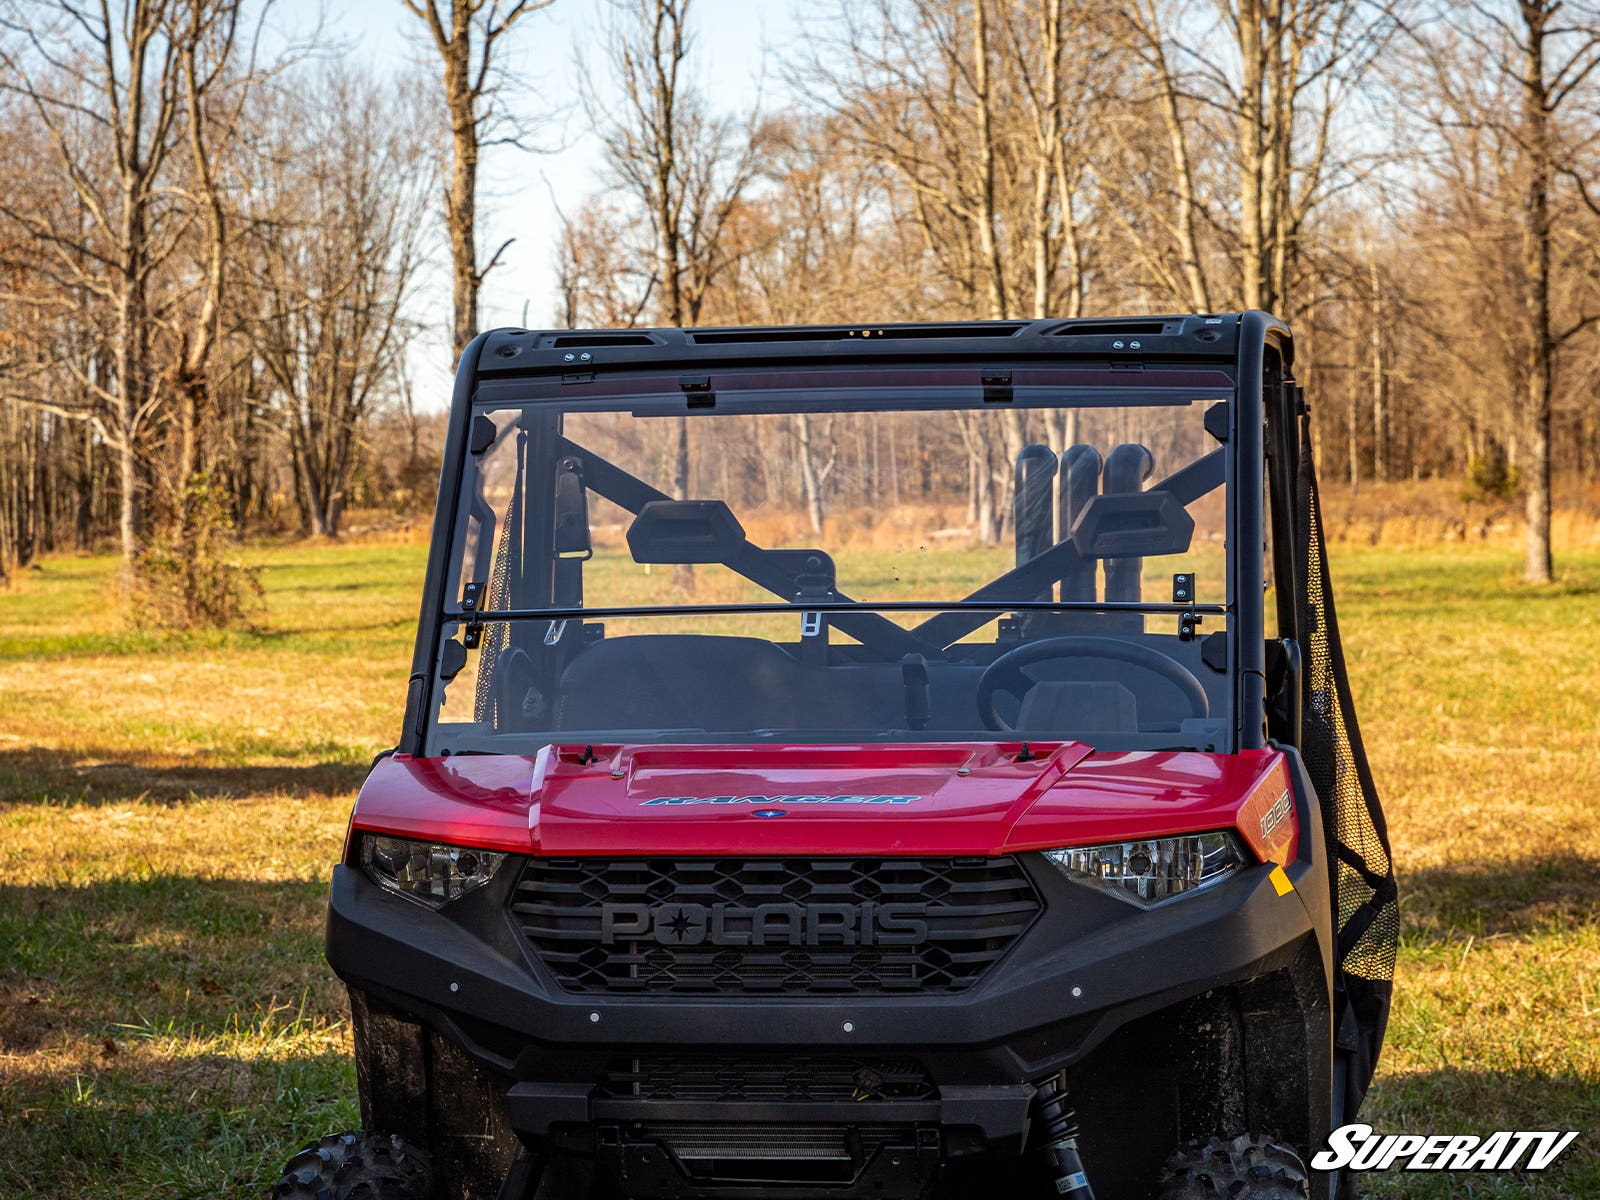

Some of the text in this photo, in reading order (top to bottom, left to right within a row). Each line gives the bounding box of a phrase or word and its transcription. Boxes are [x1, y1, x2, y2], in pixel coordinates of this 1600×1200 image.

[639, 795, 922, 807] RANGER
[1260, 788, 1292, 839] 1000
[601, 902, 928, 945] POLARIS
